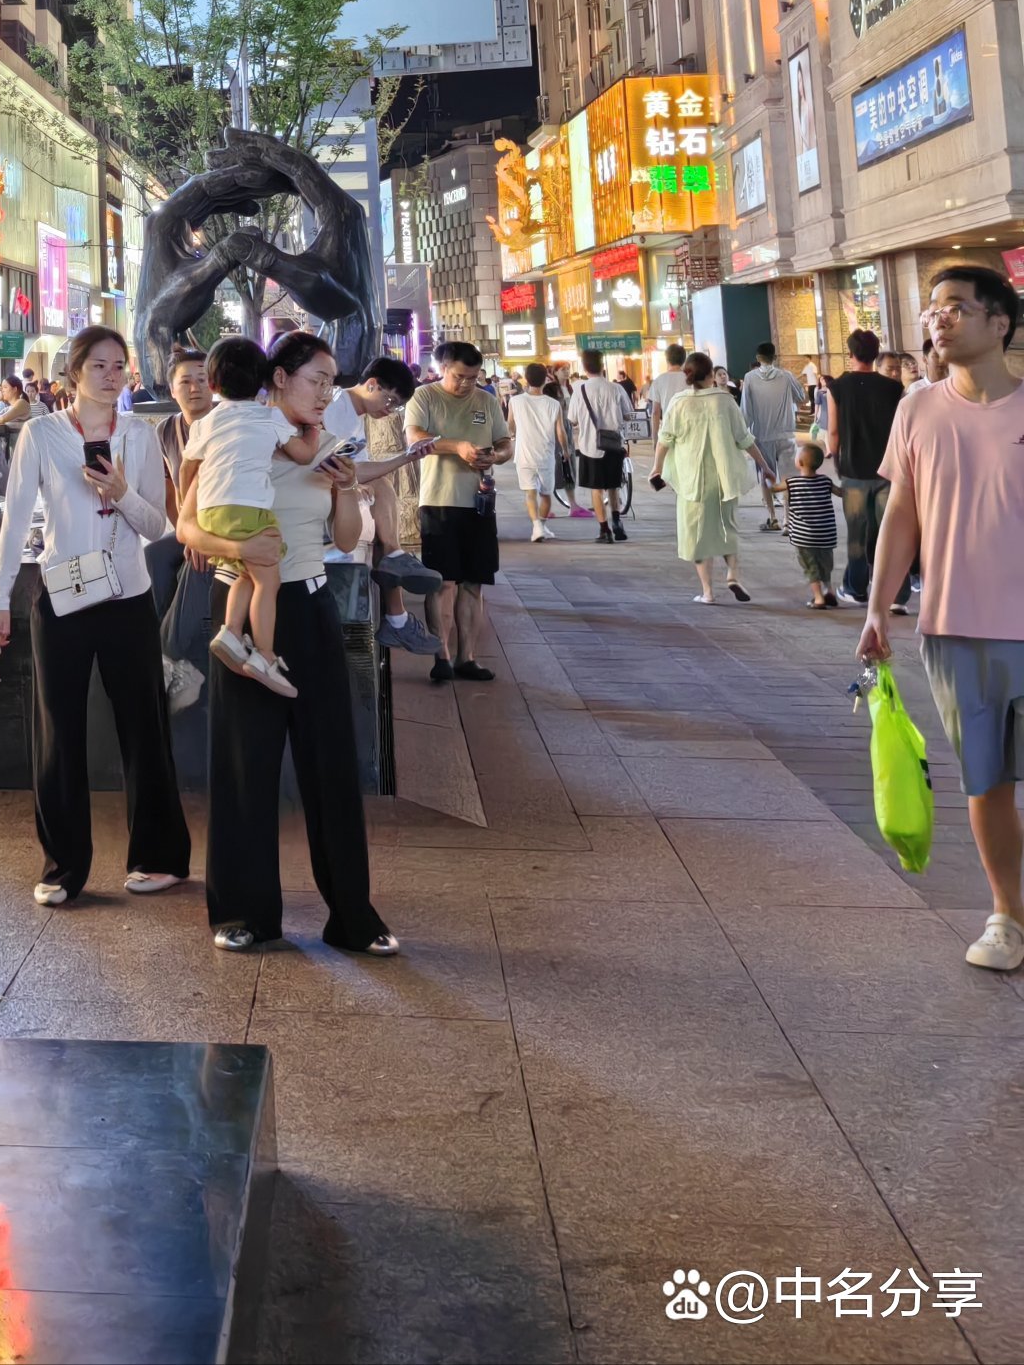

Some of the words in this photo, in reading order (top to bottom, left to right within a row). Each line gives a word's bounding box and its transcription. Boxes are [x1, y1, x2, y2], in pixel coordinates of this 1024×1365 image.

[642, 89, 705, 118] 黄金
[868, 67, 929, 133] 美的中央空调
[645, 128, 708, 156] 钻石
